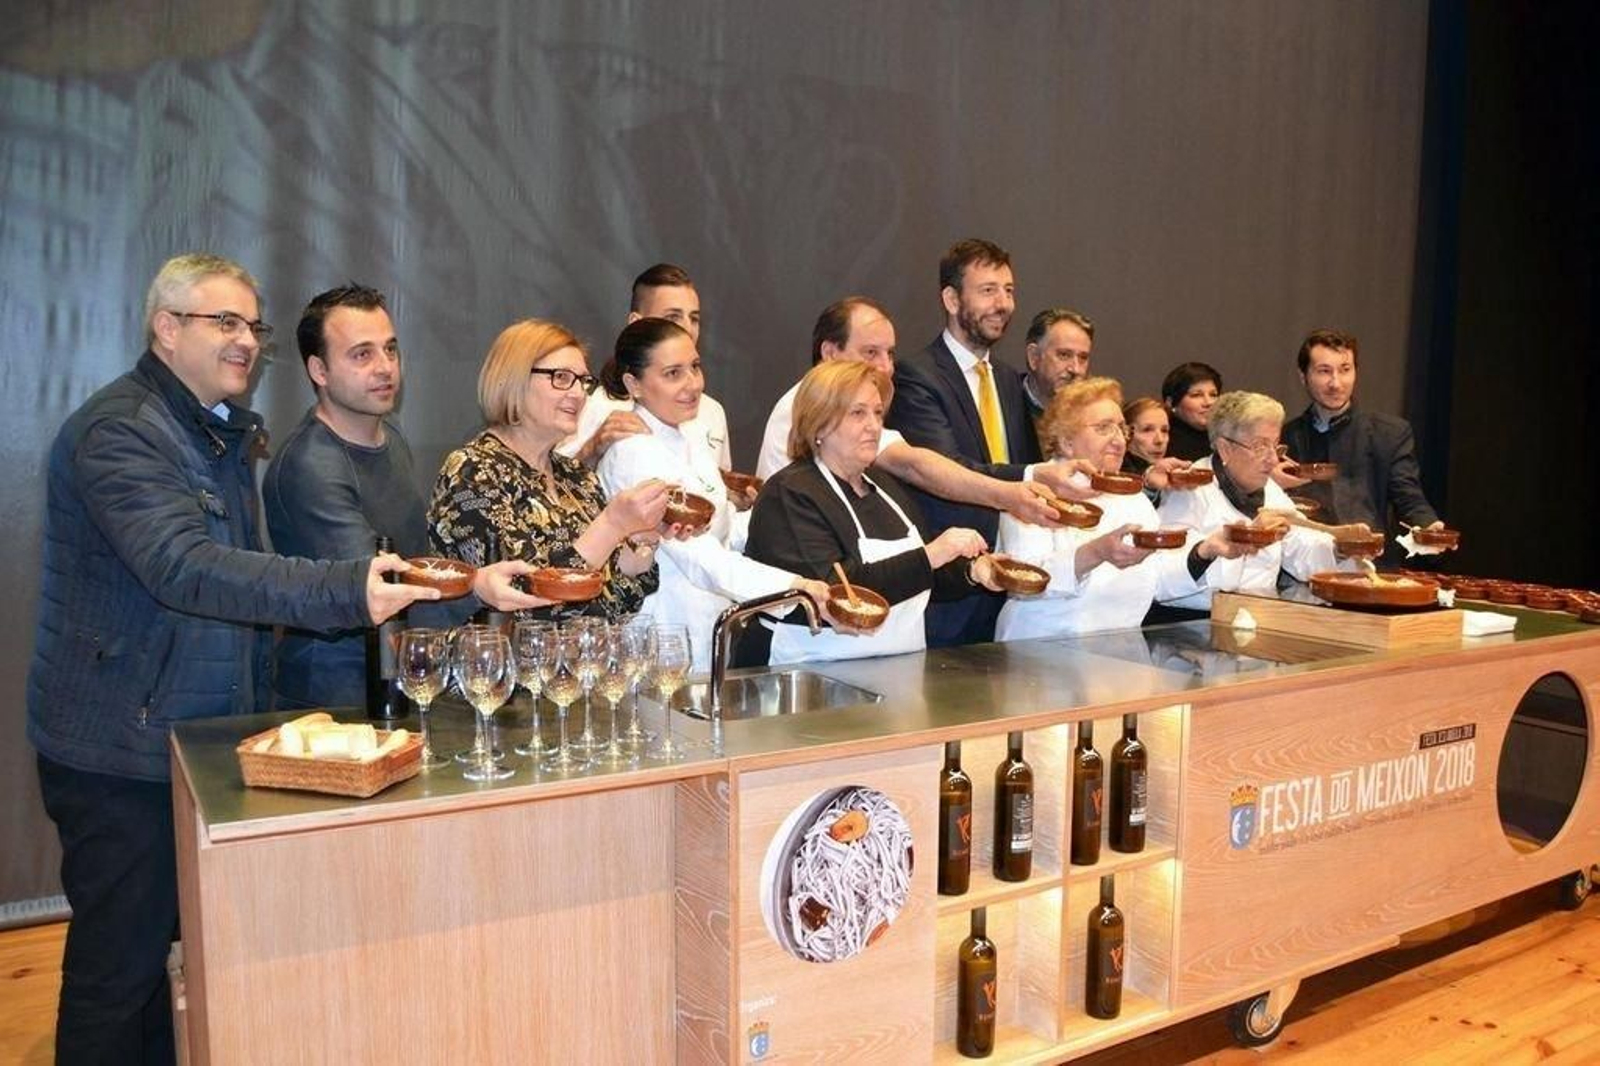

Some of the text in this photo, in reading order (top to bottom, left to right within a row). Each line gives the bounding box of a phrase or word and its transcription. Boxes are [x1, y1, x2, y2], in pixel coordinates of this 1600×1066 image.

[1259, 742, 1476, 837] FESTA DO MEIXÓN 2018
